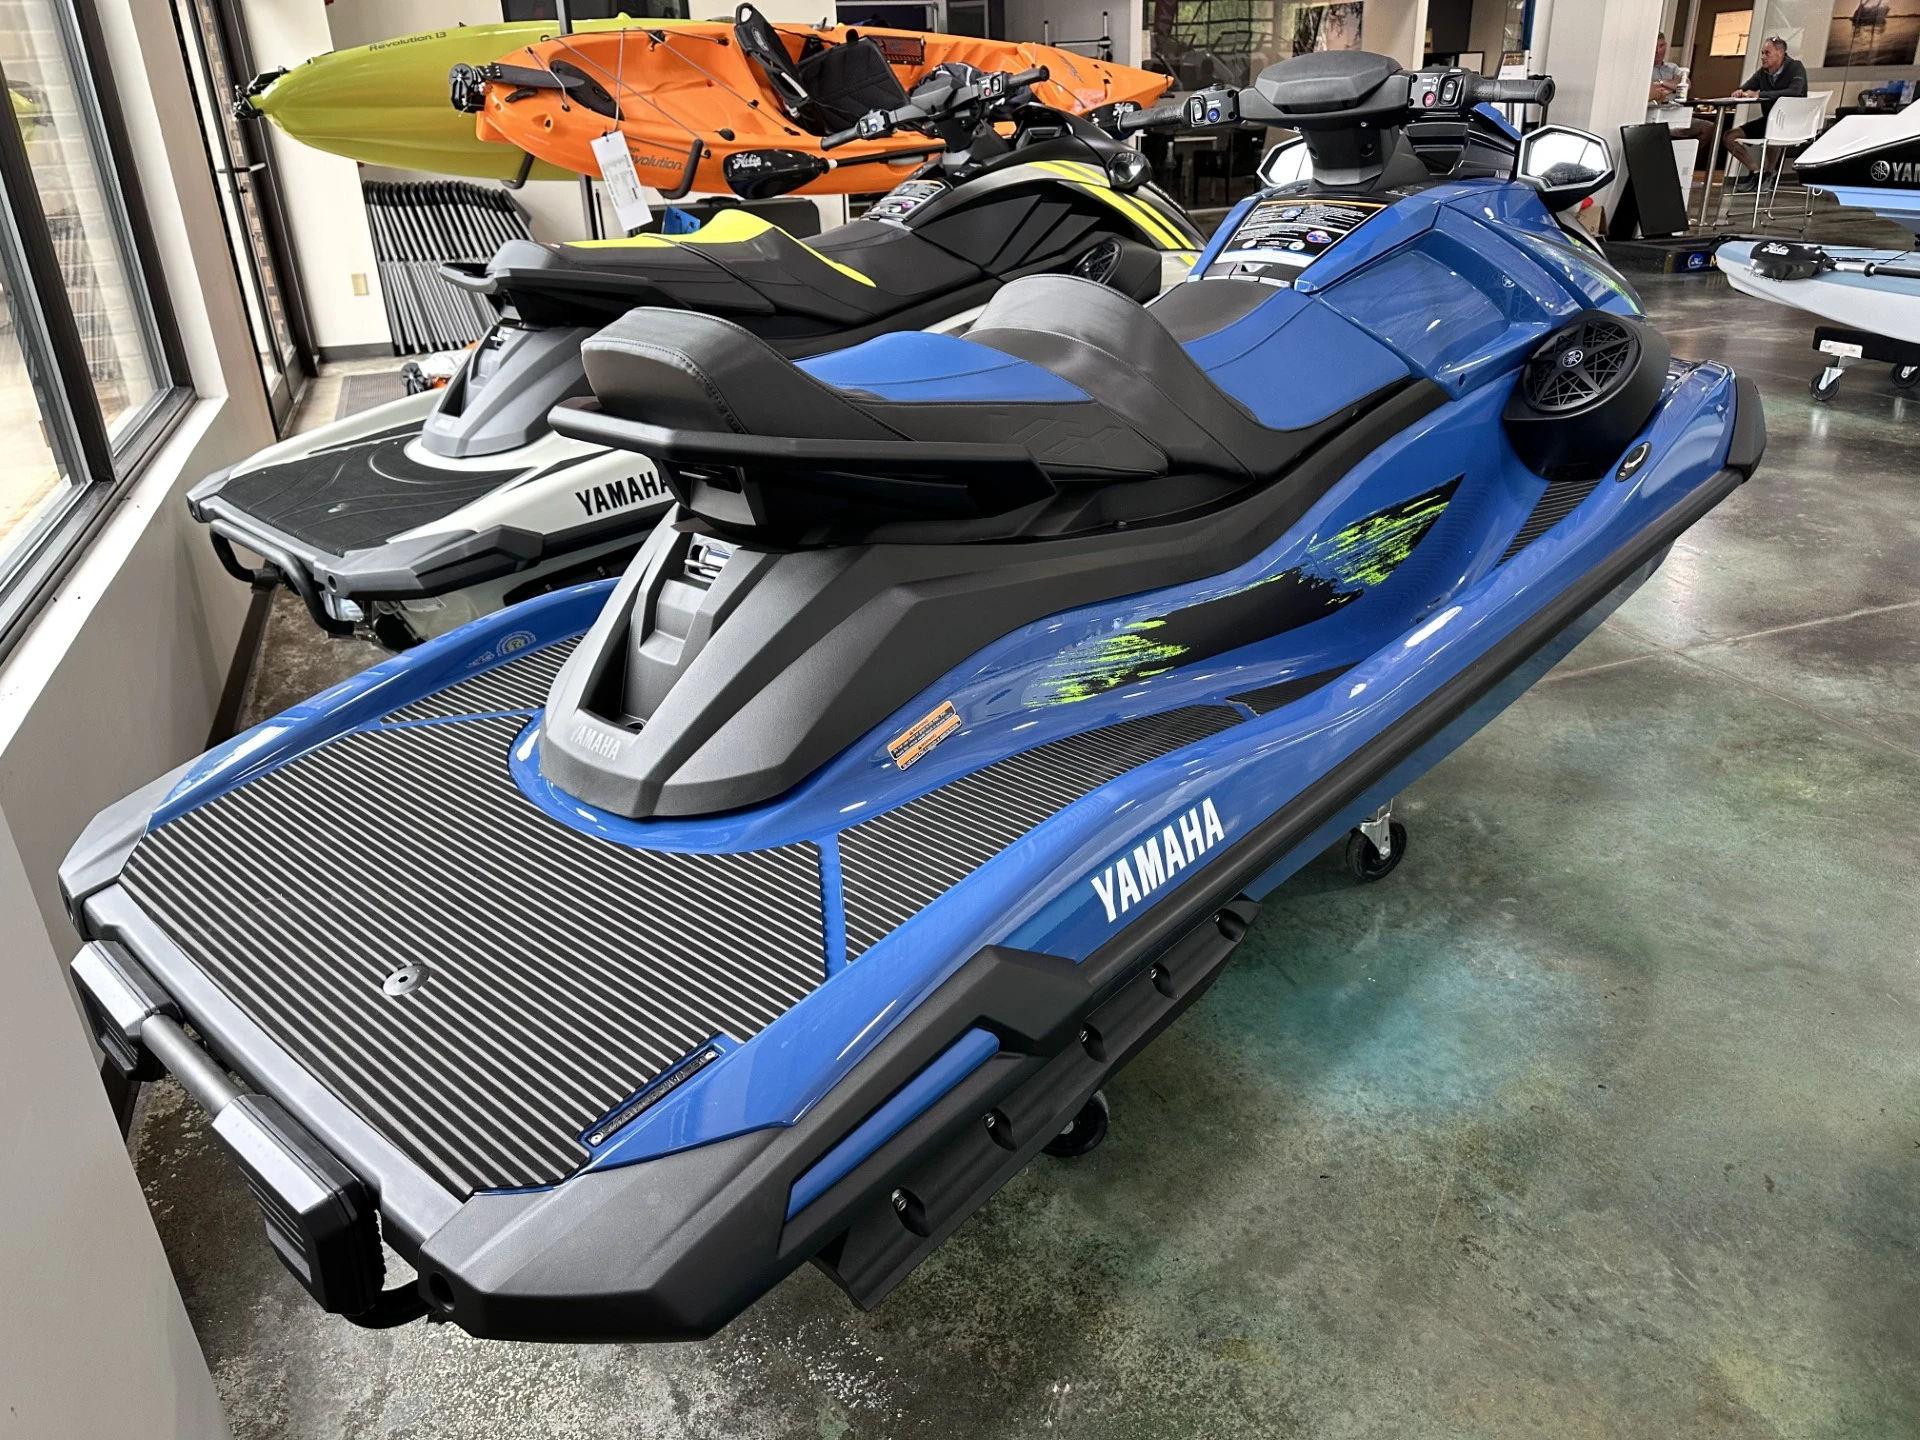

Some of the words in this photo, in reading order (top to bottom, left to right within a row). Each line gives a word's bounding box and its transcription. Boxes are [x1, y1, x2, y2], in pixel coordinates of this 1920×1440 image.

[369, 34, 433, 51] Revolution
[435, 31, 447, 39] 13
[570, 725, 621, 761] YAMAHA
[1090, 797, 1226, 924] YAMAHA
